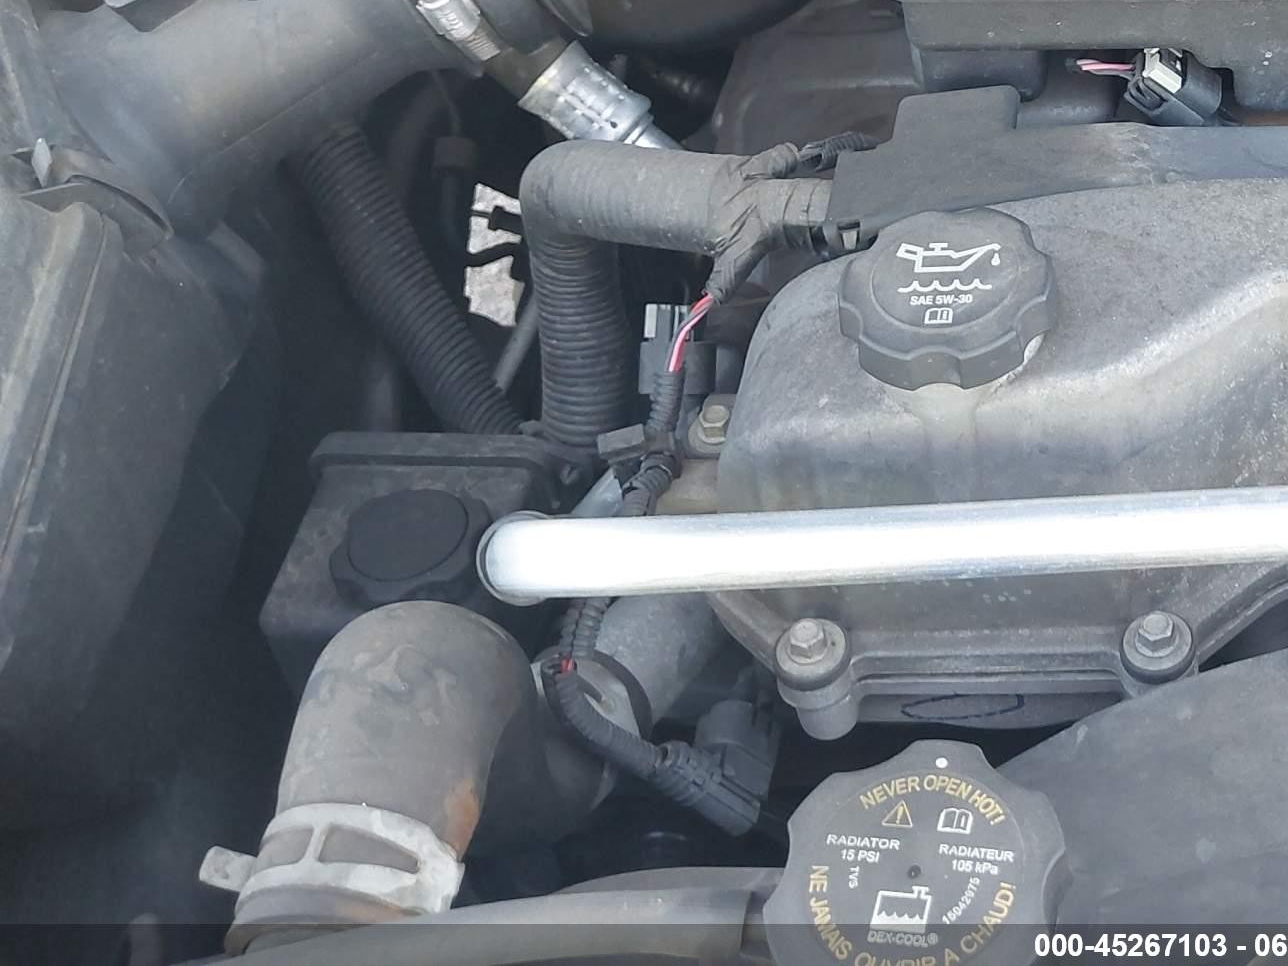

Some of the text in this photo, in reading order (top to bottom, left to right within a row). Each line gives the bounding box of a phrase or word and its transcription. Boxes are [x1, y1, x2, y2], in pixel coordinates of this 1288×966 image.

[910, 294, 973, 306] SAE 5W-30
[859, 774, 1006, 825] NEVER OPEN HOT!
[826, 833, 901, 851] RADIATOR
[841, 849, 880, 863] 15 PSI
[938, 843, 1015, 863] RADIATEUR
[952, 859, 999, 875] 105 kPa
[808, 865, 830, 893] NE
[960, 881, 1017, 954] CHAUD!
[809, 896, 852, 960] JAMAIS
